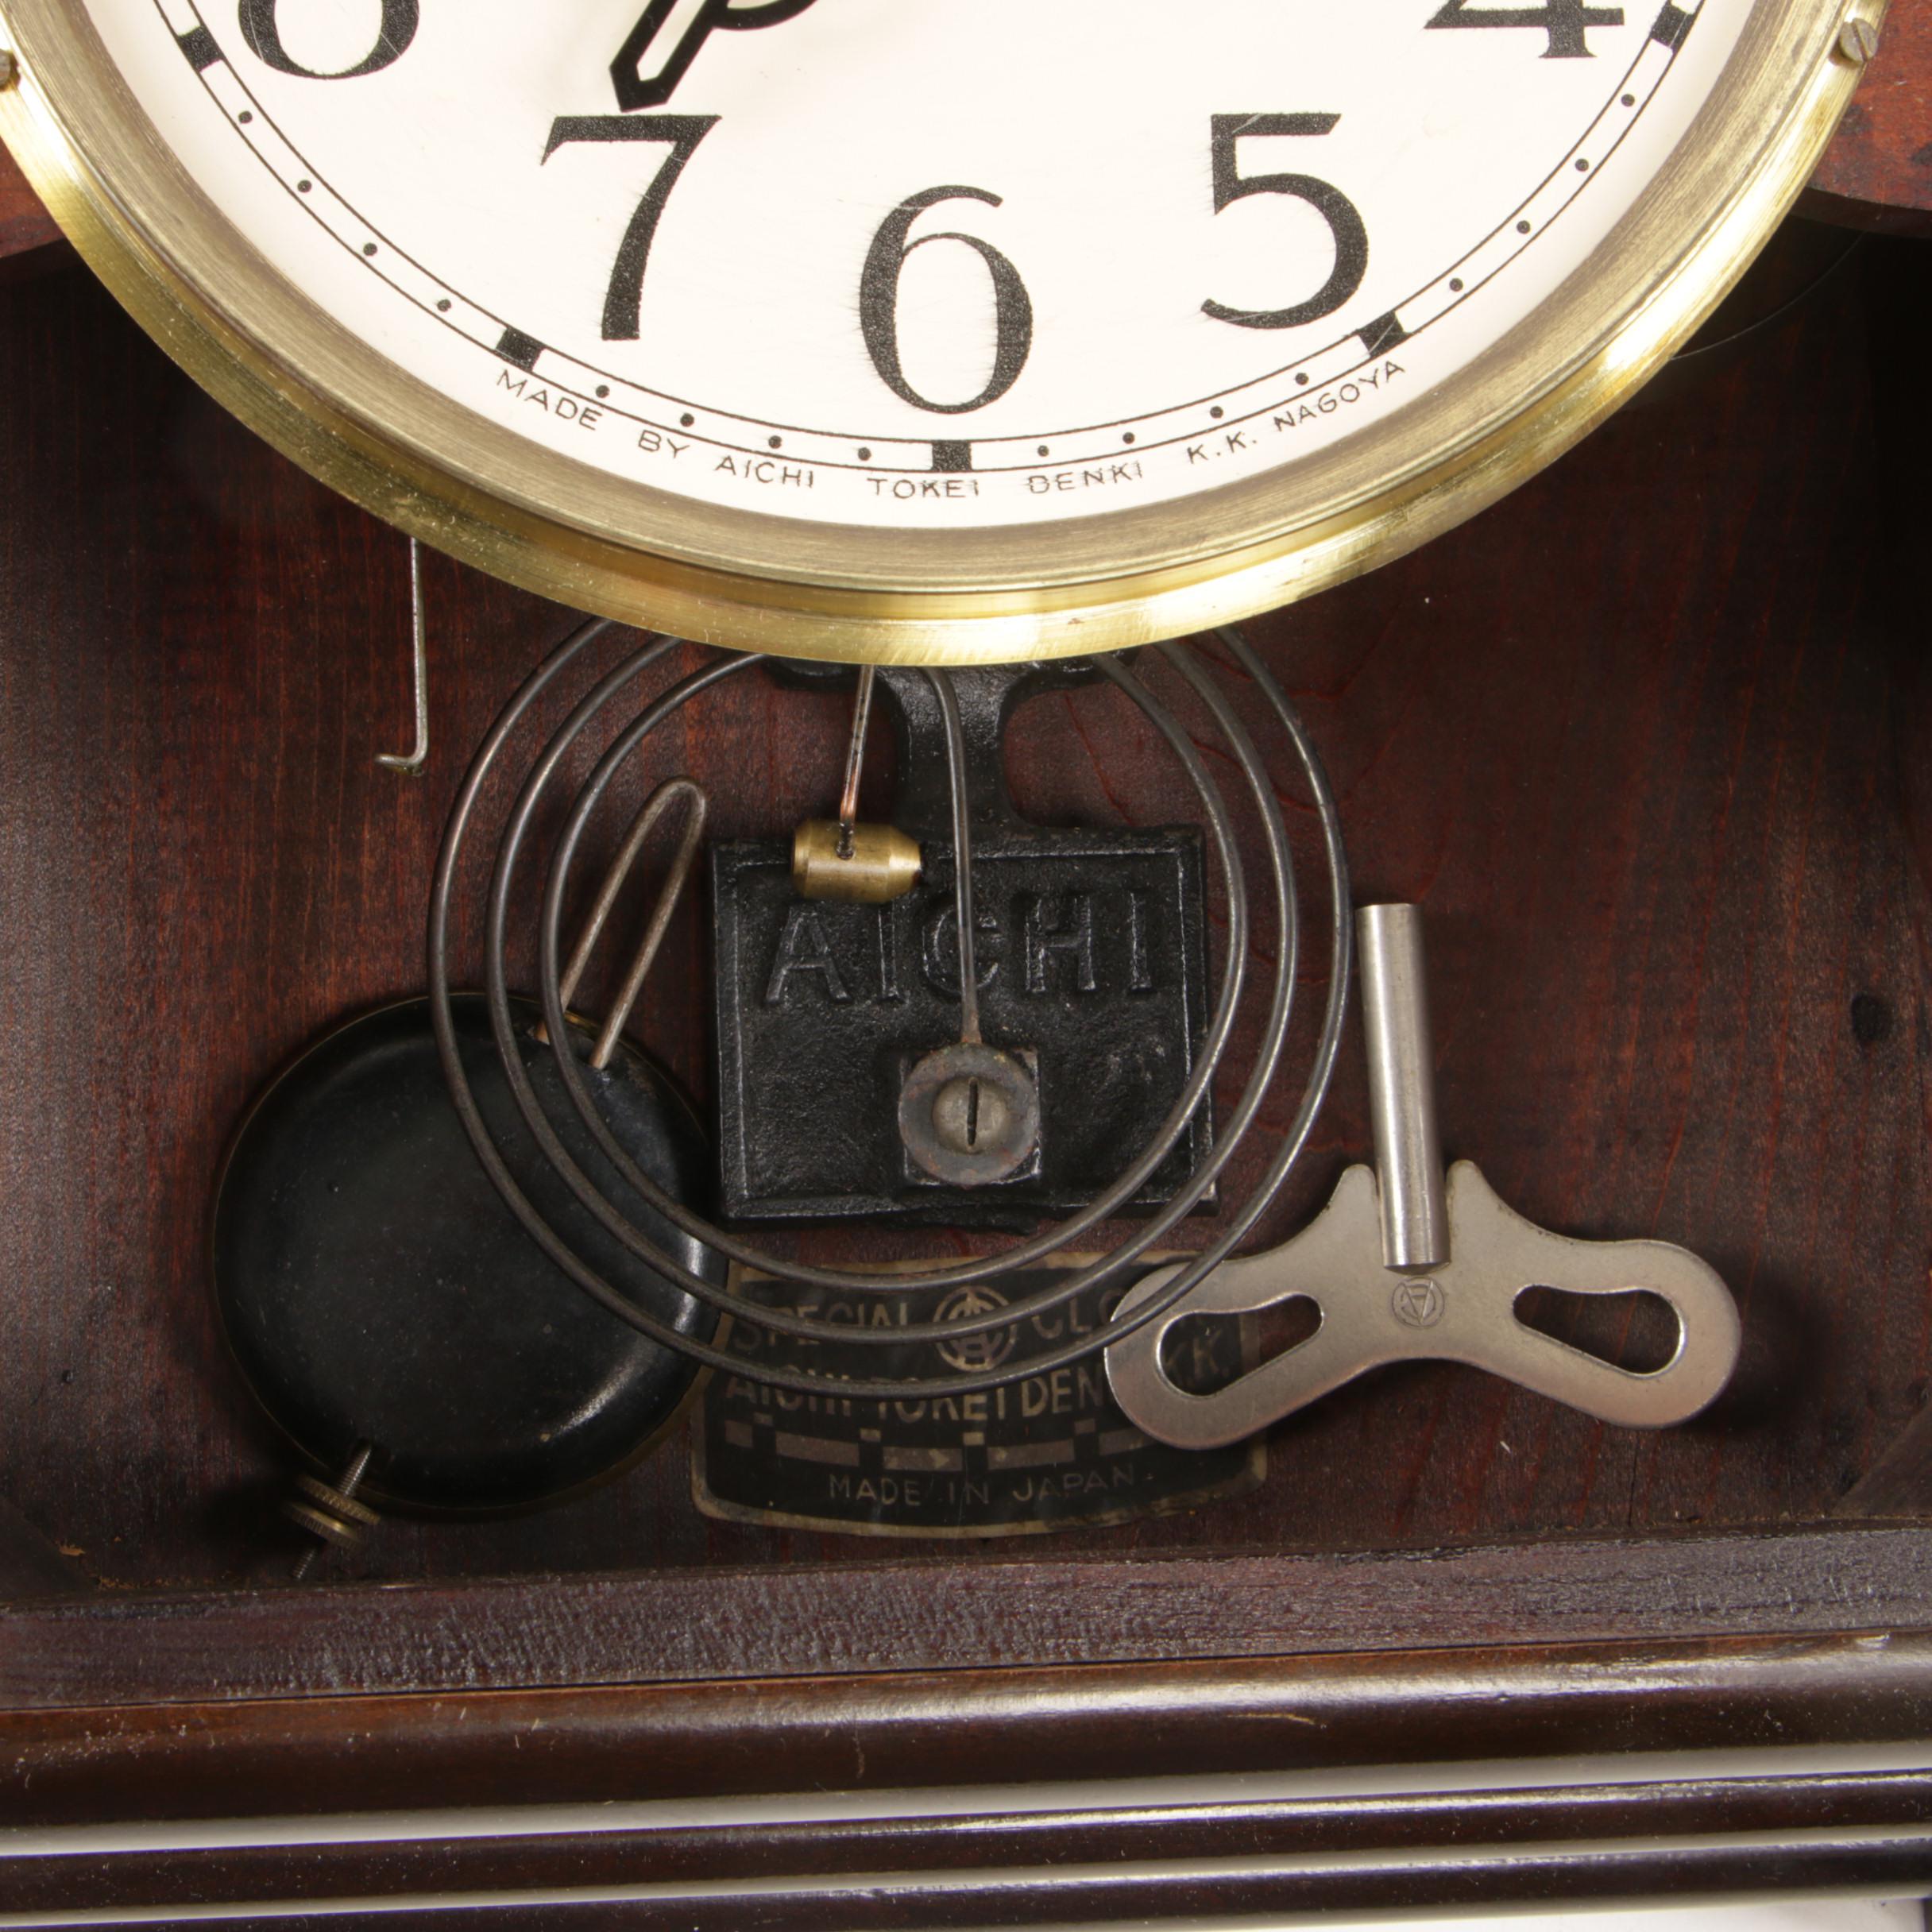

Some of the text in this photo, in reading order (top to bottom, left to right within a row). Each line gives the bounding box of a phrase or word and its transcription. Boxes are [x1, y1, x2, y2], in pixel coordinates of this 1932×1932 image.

[541, 114, 722, 340] 7
[860, 184, 1033, 414] 6
[1200, 114, 1368, 330] 5
[497, 361, 1405, 500] MADE BY AICHI TOKEI DENKI K.K. NAGOYA
[765, 891, 1153, 1005] AICHI
[828, 1462, 1135, 1508] MADE IN JAPAN
